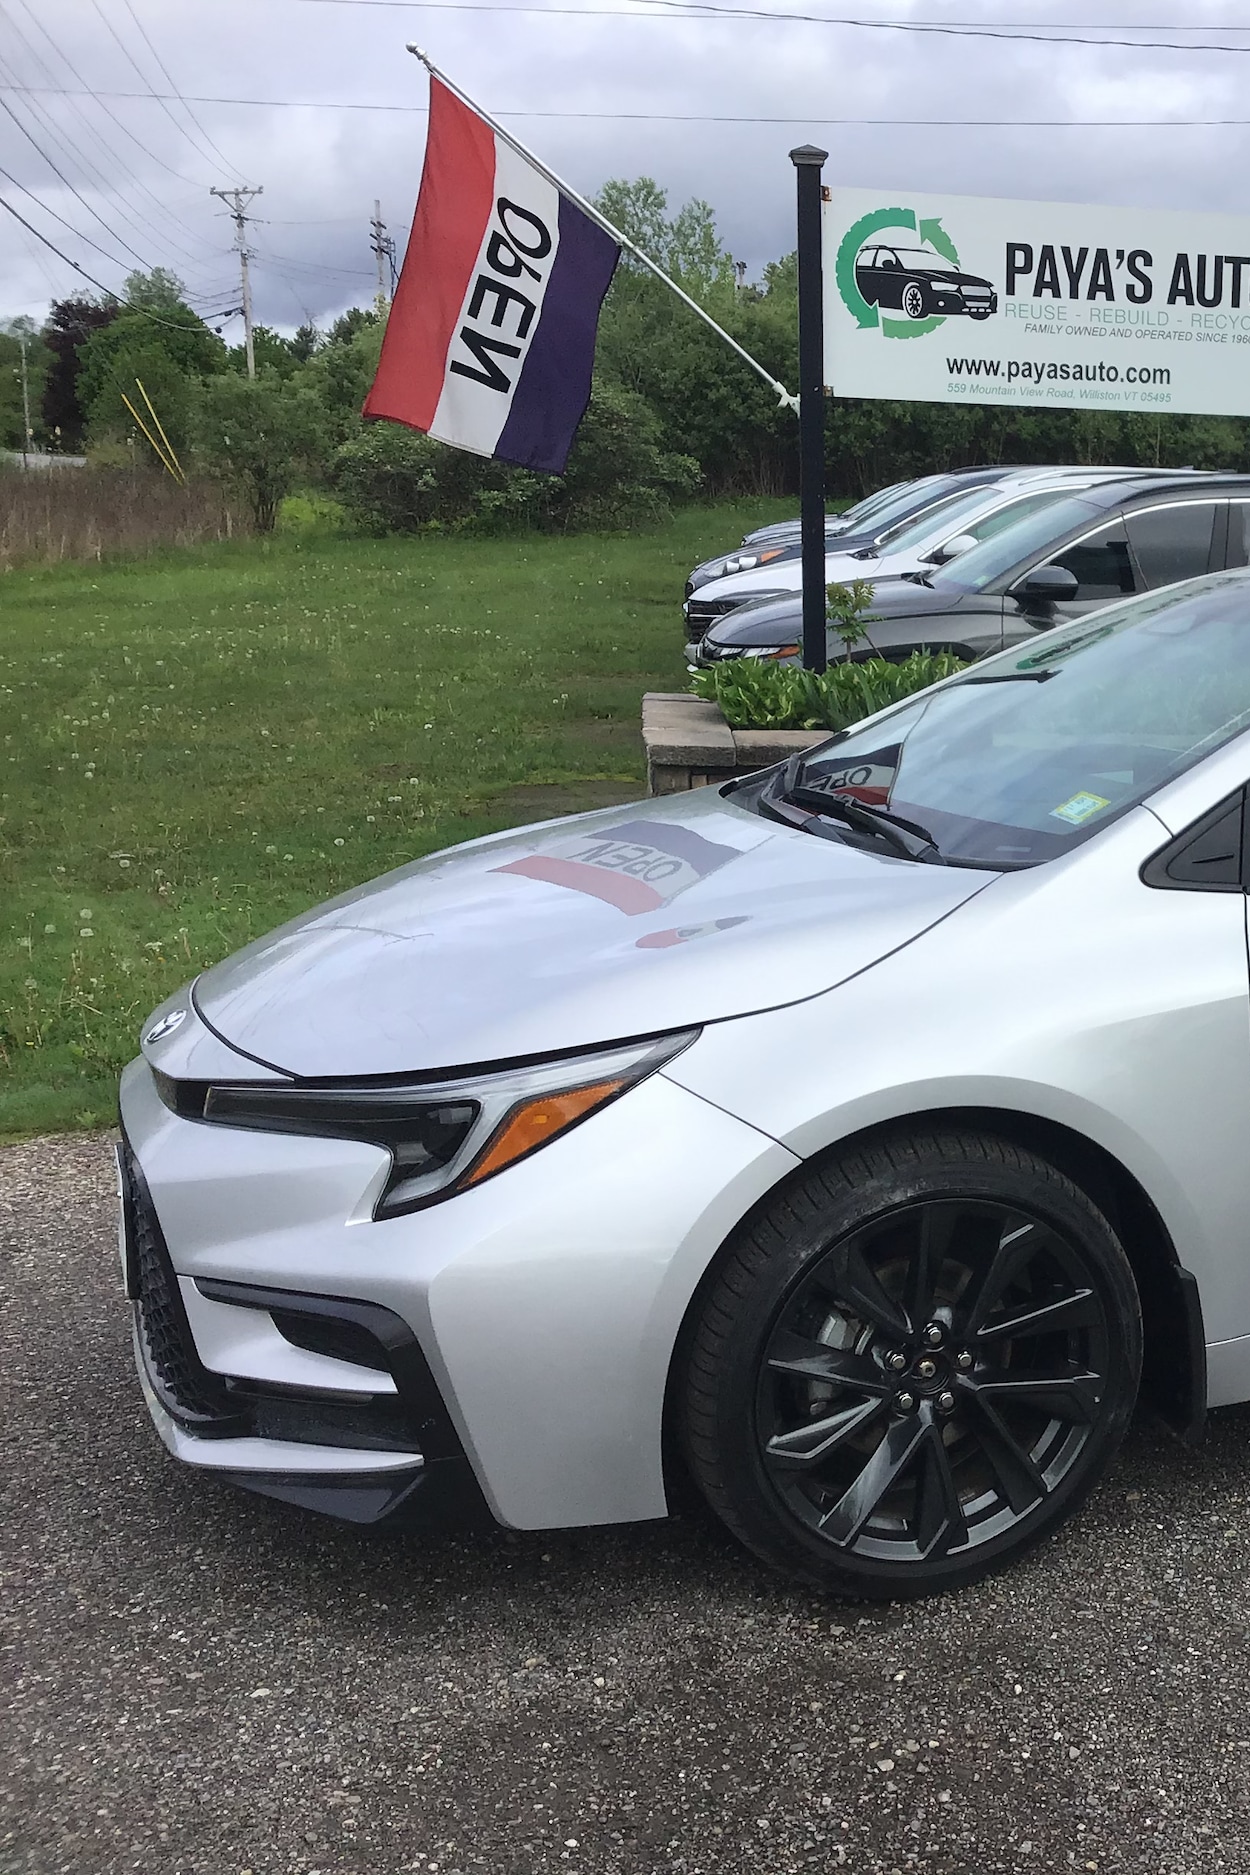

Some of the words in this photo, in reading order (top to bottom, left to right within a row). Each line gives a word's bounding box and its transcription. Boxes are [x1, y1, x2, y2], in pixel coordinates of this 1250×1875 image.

[1006, 242, 1153, 304] PAYA'S
[1004, 303, 1067, 321] REUSE
[1090, 308, 1169, 326] REBUILD
[1024, 323, 1063, 335] FAMILY
[1065, 325, 1107, 337] OWNED
[1109, 328, 1133, 339] AND
[1135, 329, 1192, 342] OPERATED
[1195, 332, 1228, 343] SINCE
[946, 357, 1171, 384] www.payasauto.com
[947, 382, 967, 393] 559
[969, 384, 1016, 396] Mountain
[1020, 386, 1043, 397] View
[1046, 388, 1076, 399] Road,
[1079, 389, 1120, 401] Williston
[1124, 391, 1138, 401] VT
[1140, 392, 1172, 403] 05495
[565, 842, 683, 882] OPEN
